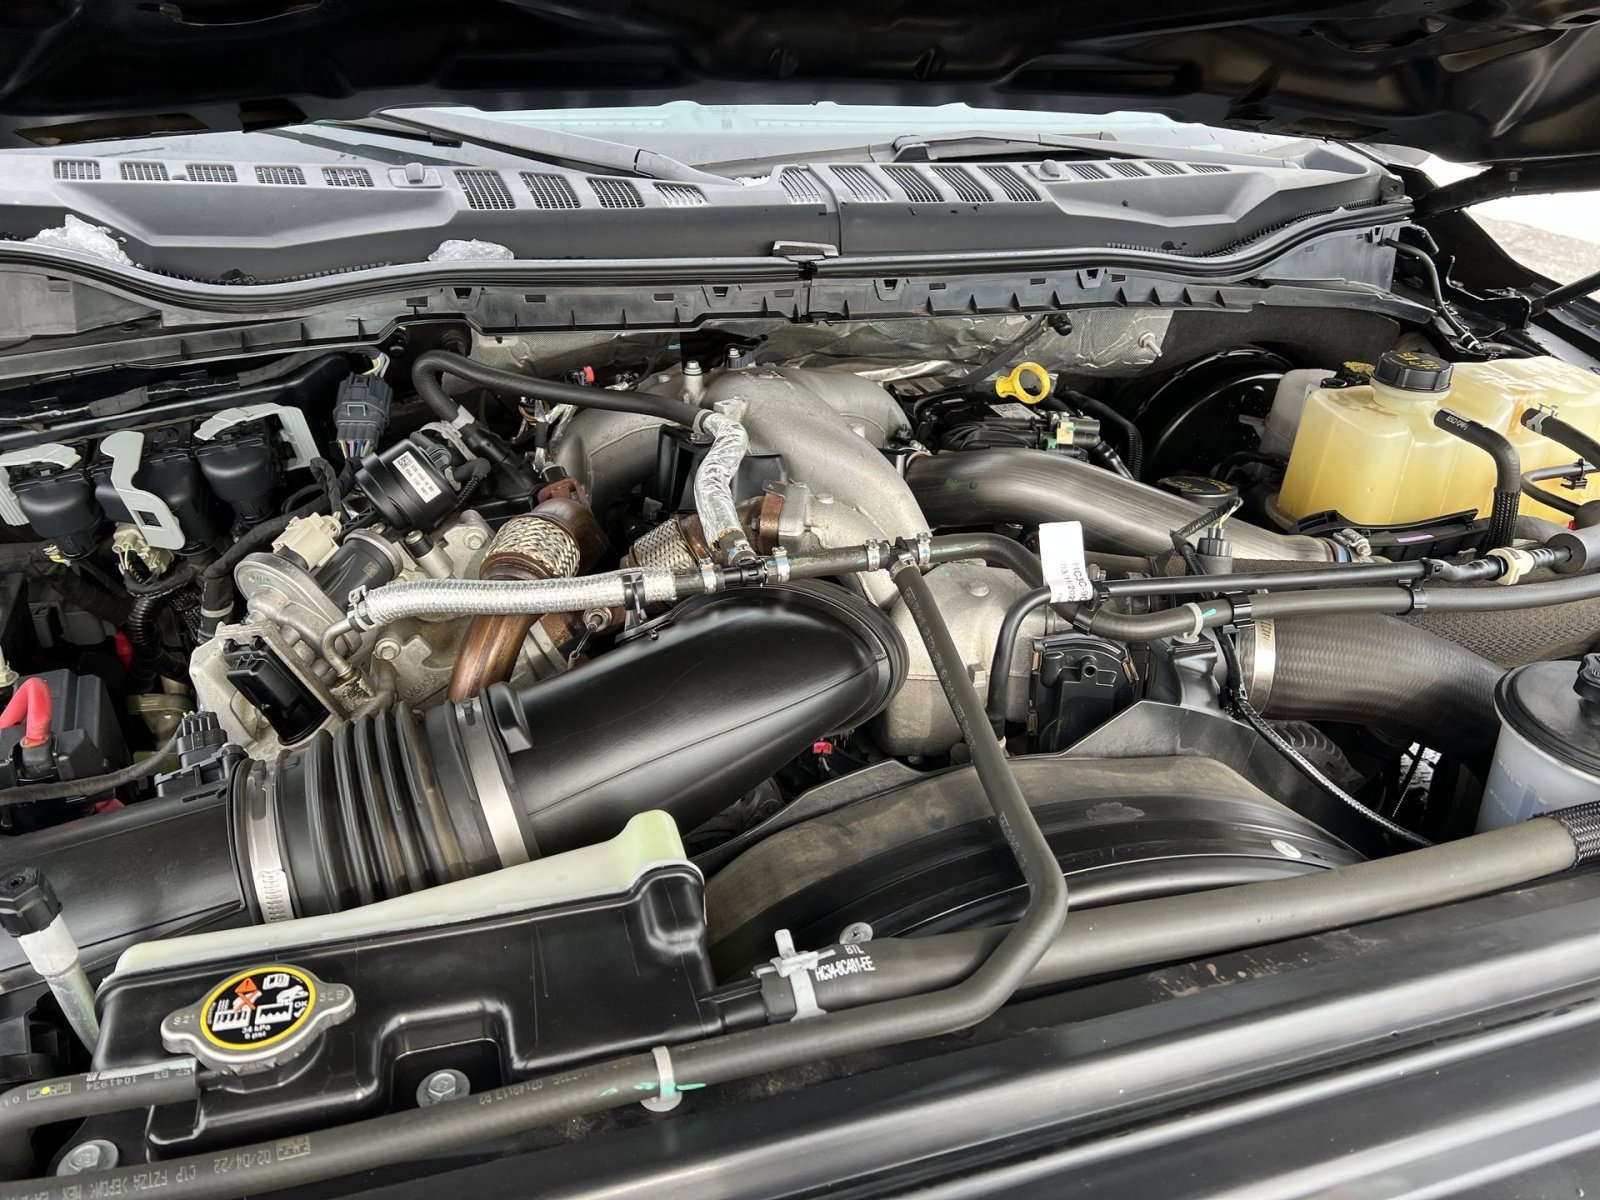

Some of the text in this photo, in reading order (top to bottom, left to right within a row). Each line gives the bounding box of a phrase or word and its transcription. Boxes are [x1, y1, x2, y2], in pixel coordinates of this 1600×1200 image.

[844, 943, 865, 955] BTL
[294, 1000, 309, 1009] OK
[254, 1024, 271, 1032] kPa
[252, 1031, 266, 1040] psi
[214, 1149, 271, 1174] 02/04/22
